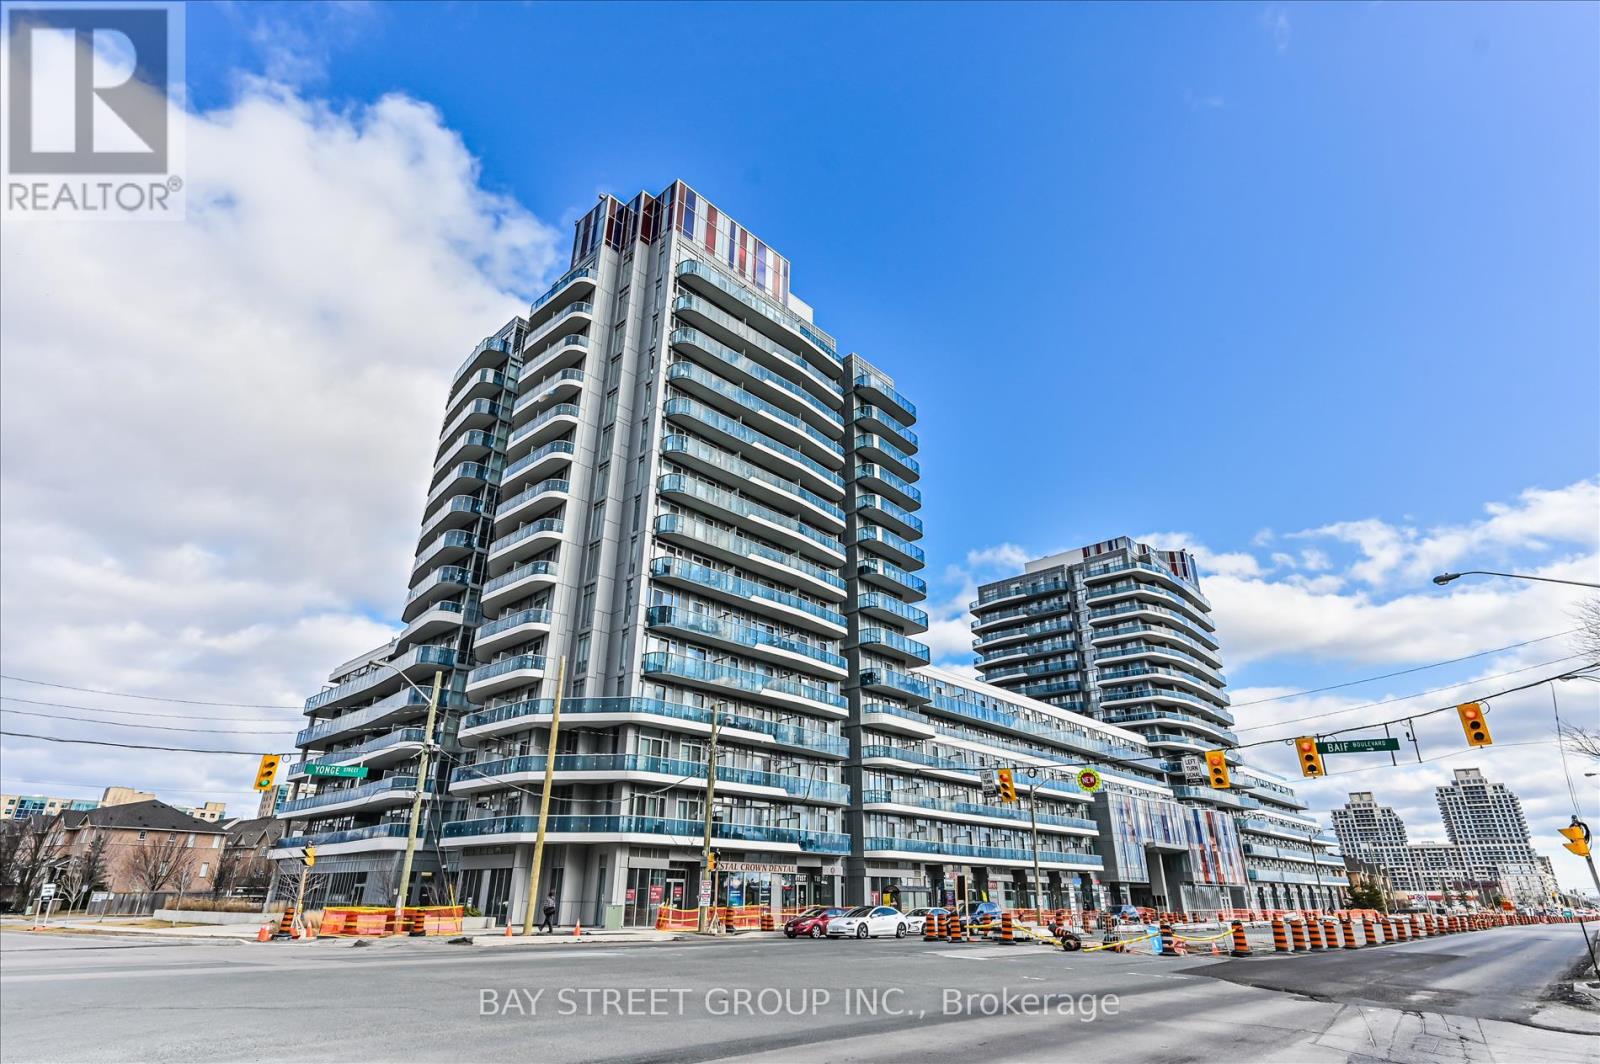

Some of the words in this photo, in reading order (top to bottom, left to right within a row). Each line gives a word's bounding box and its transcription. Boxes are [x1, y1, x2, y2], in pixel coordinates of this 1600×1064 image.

[1327, 742, 1349, 753] BAIF
[315, 766, 340, 775] YONGE
[720, 862, 738, 872] STAL
[740, 863, 767, 872] CROWN
[769, 864, 795, 873] DENTAL
